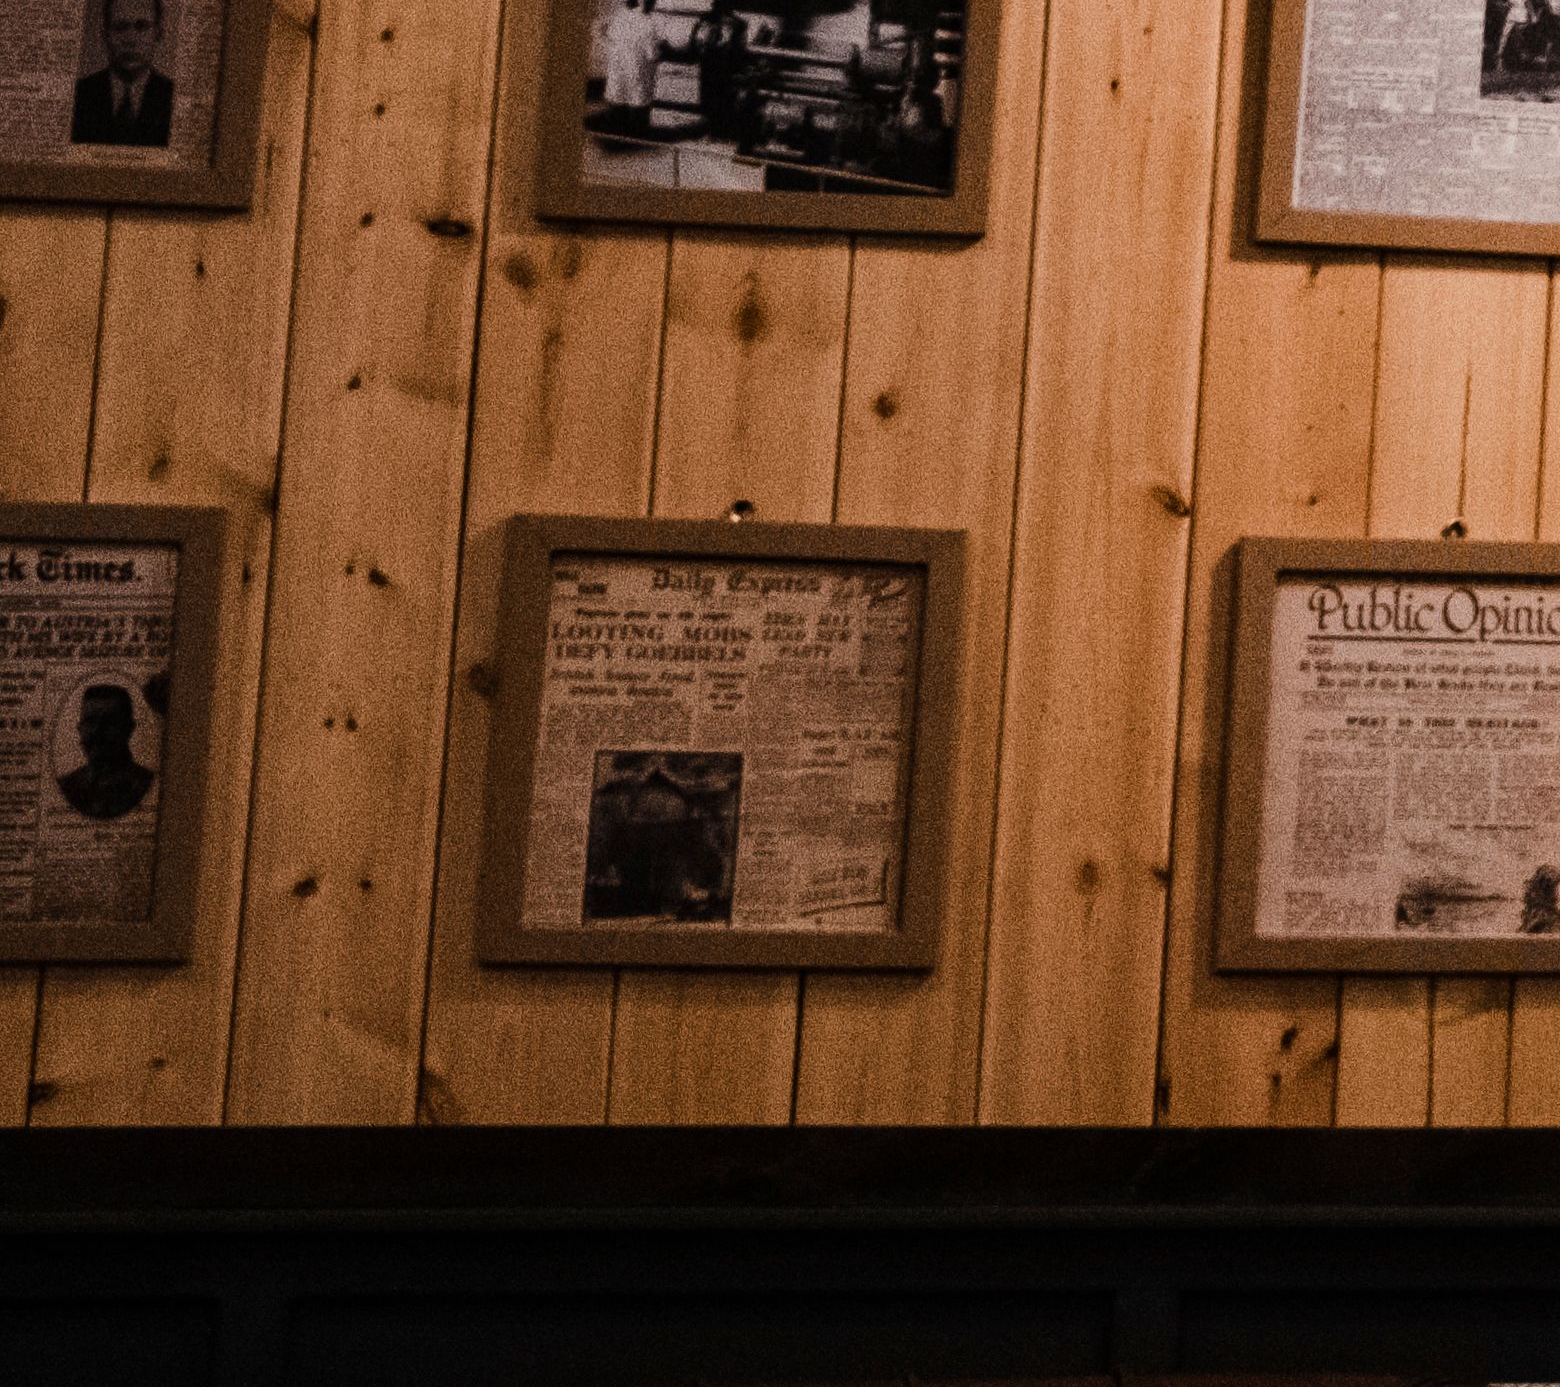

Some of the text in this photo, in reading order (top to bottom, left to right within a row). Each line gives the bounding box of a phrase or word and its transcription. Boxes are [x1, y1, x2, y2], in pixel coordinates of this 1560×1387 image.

[652, 568, 821, 597] Daily Express
[1308, 583, 1435, 633] Public
[552, 623, 753, 643] LOOTING MOBS
[555, 643, 747, 662] DEFY GOEBBELS
